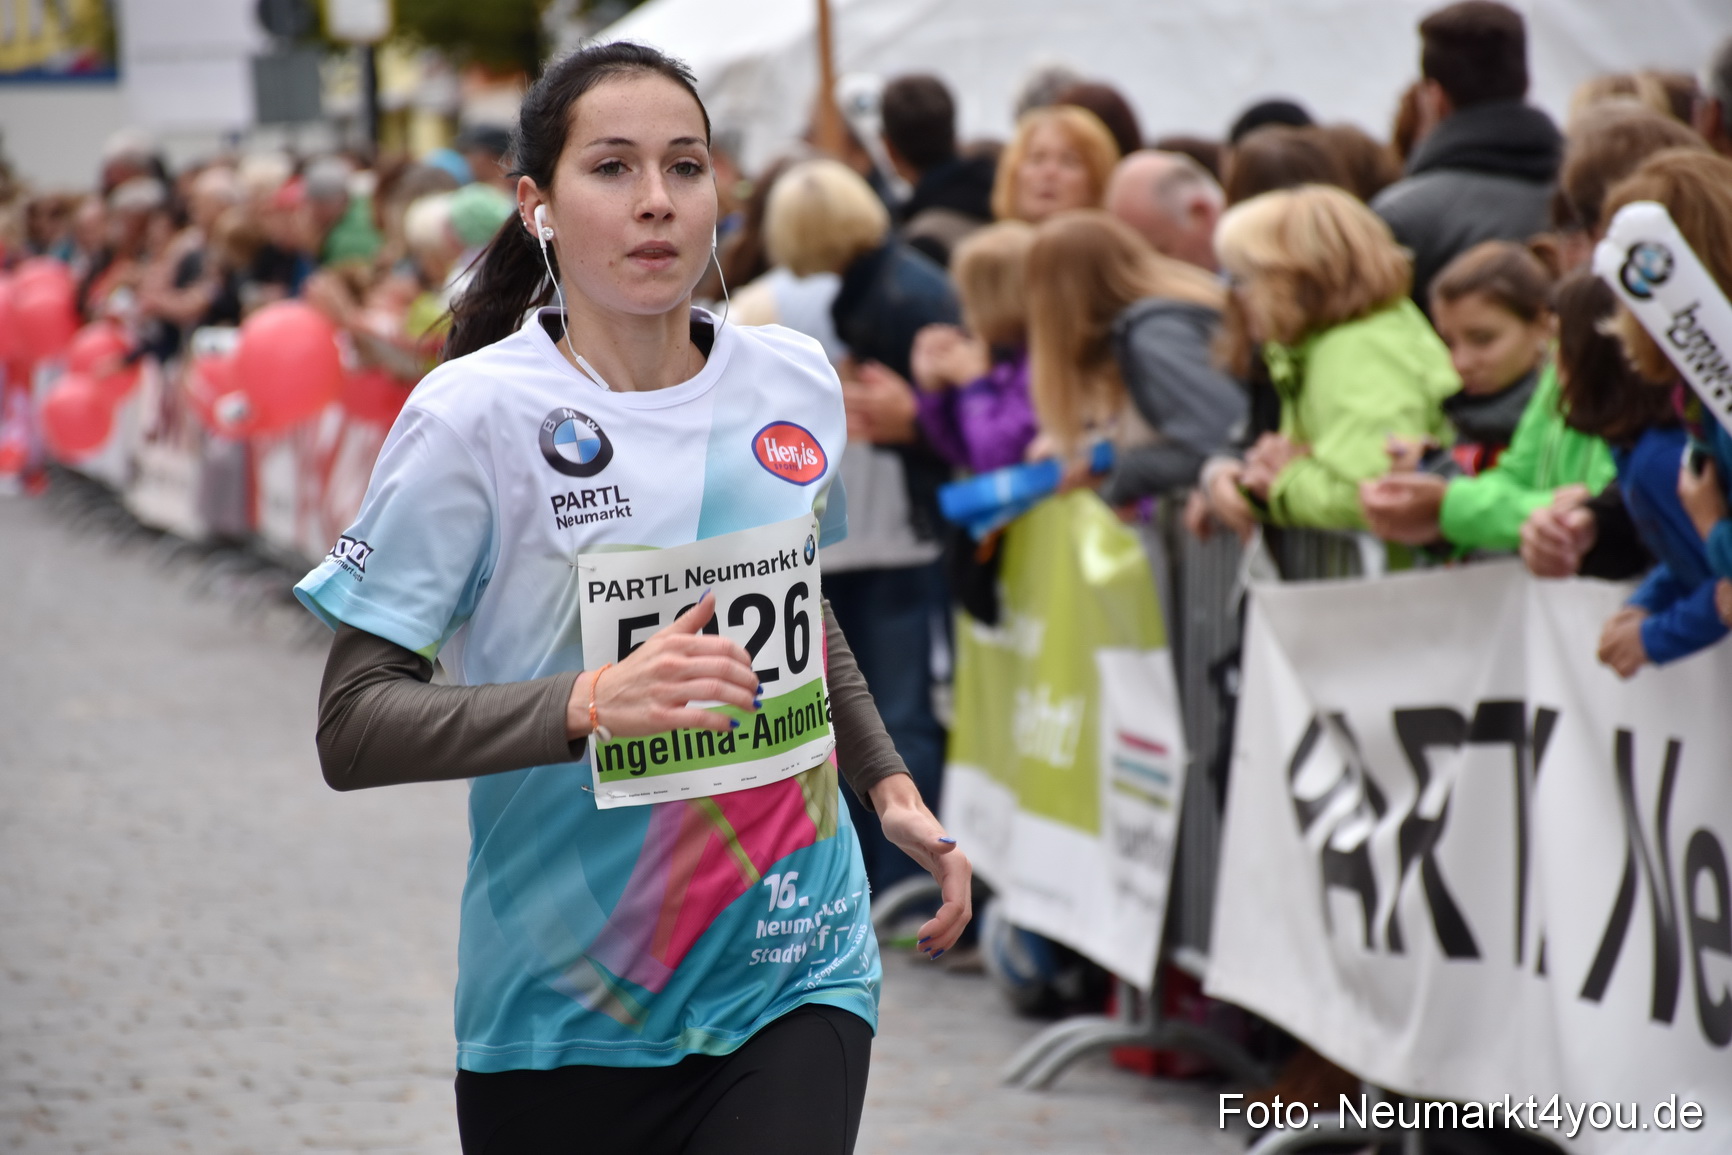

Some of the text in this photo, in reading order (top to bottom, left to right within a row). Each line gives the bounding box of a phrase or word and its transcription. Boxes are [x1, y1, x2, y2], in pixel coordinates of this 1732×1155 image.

[543, 408, 599, 433] BMW
[763, 437, 818, 470] Hervis
[550, 485, 630, 515] PARTL
[556, 504, 632, 530] Neumarkt
[588, 549, 798, 603] PARTL Neumarkt
[763, 871, 809, 912] 16.
